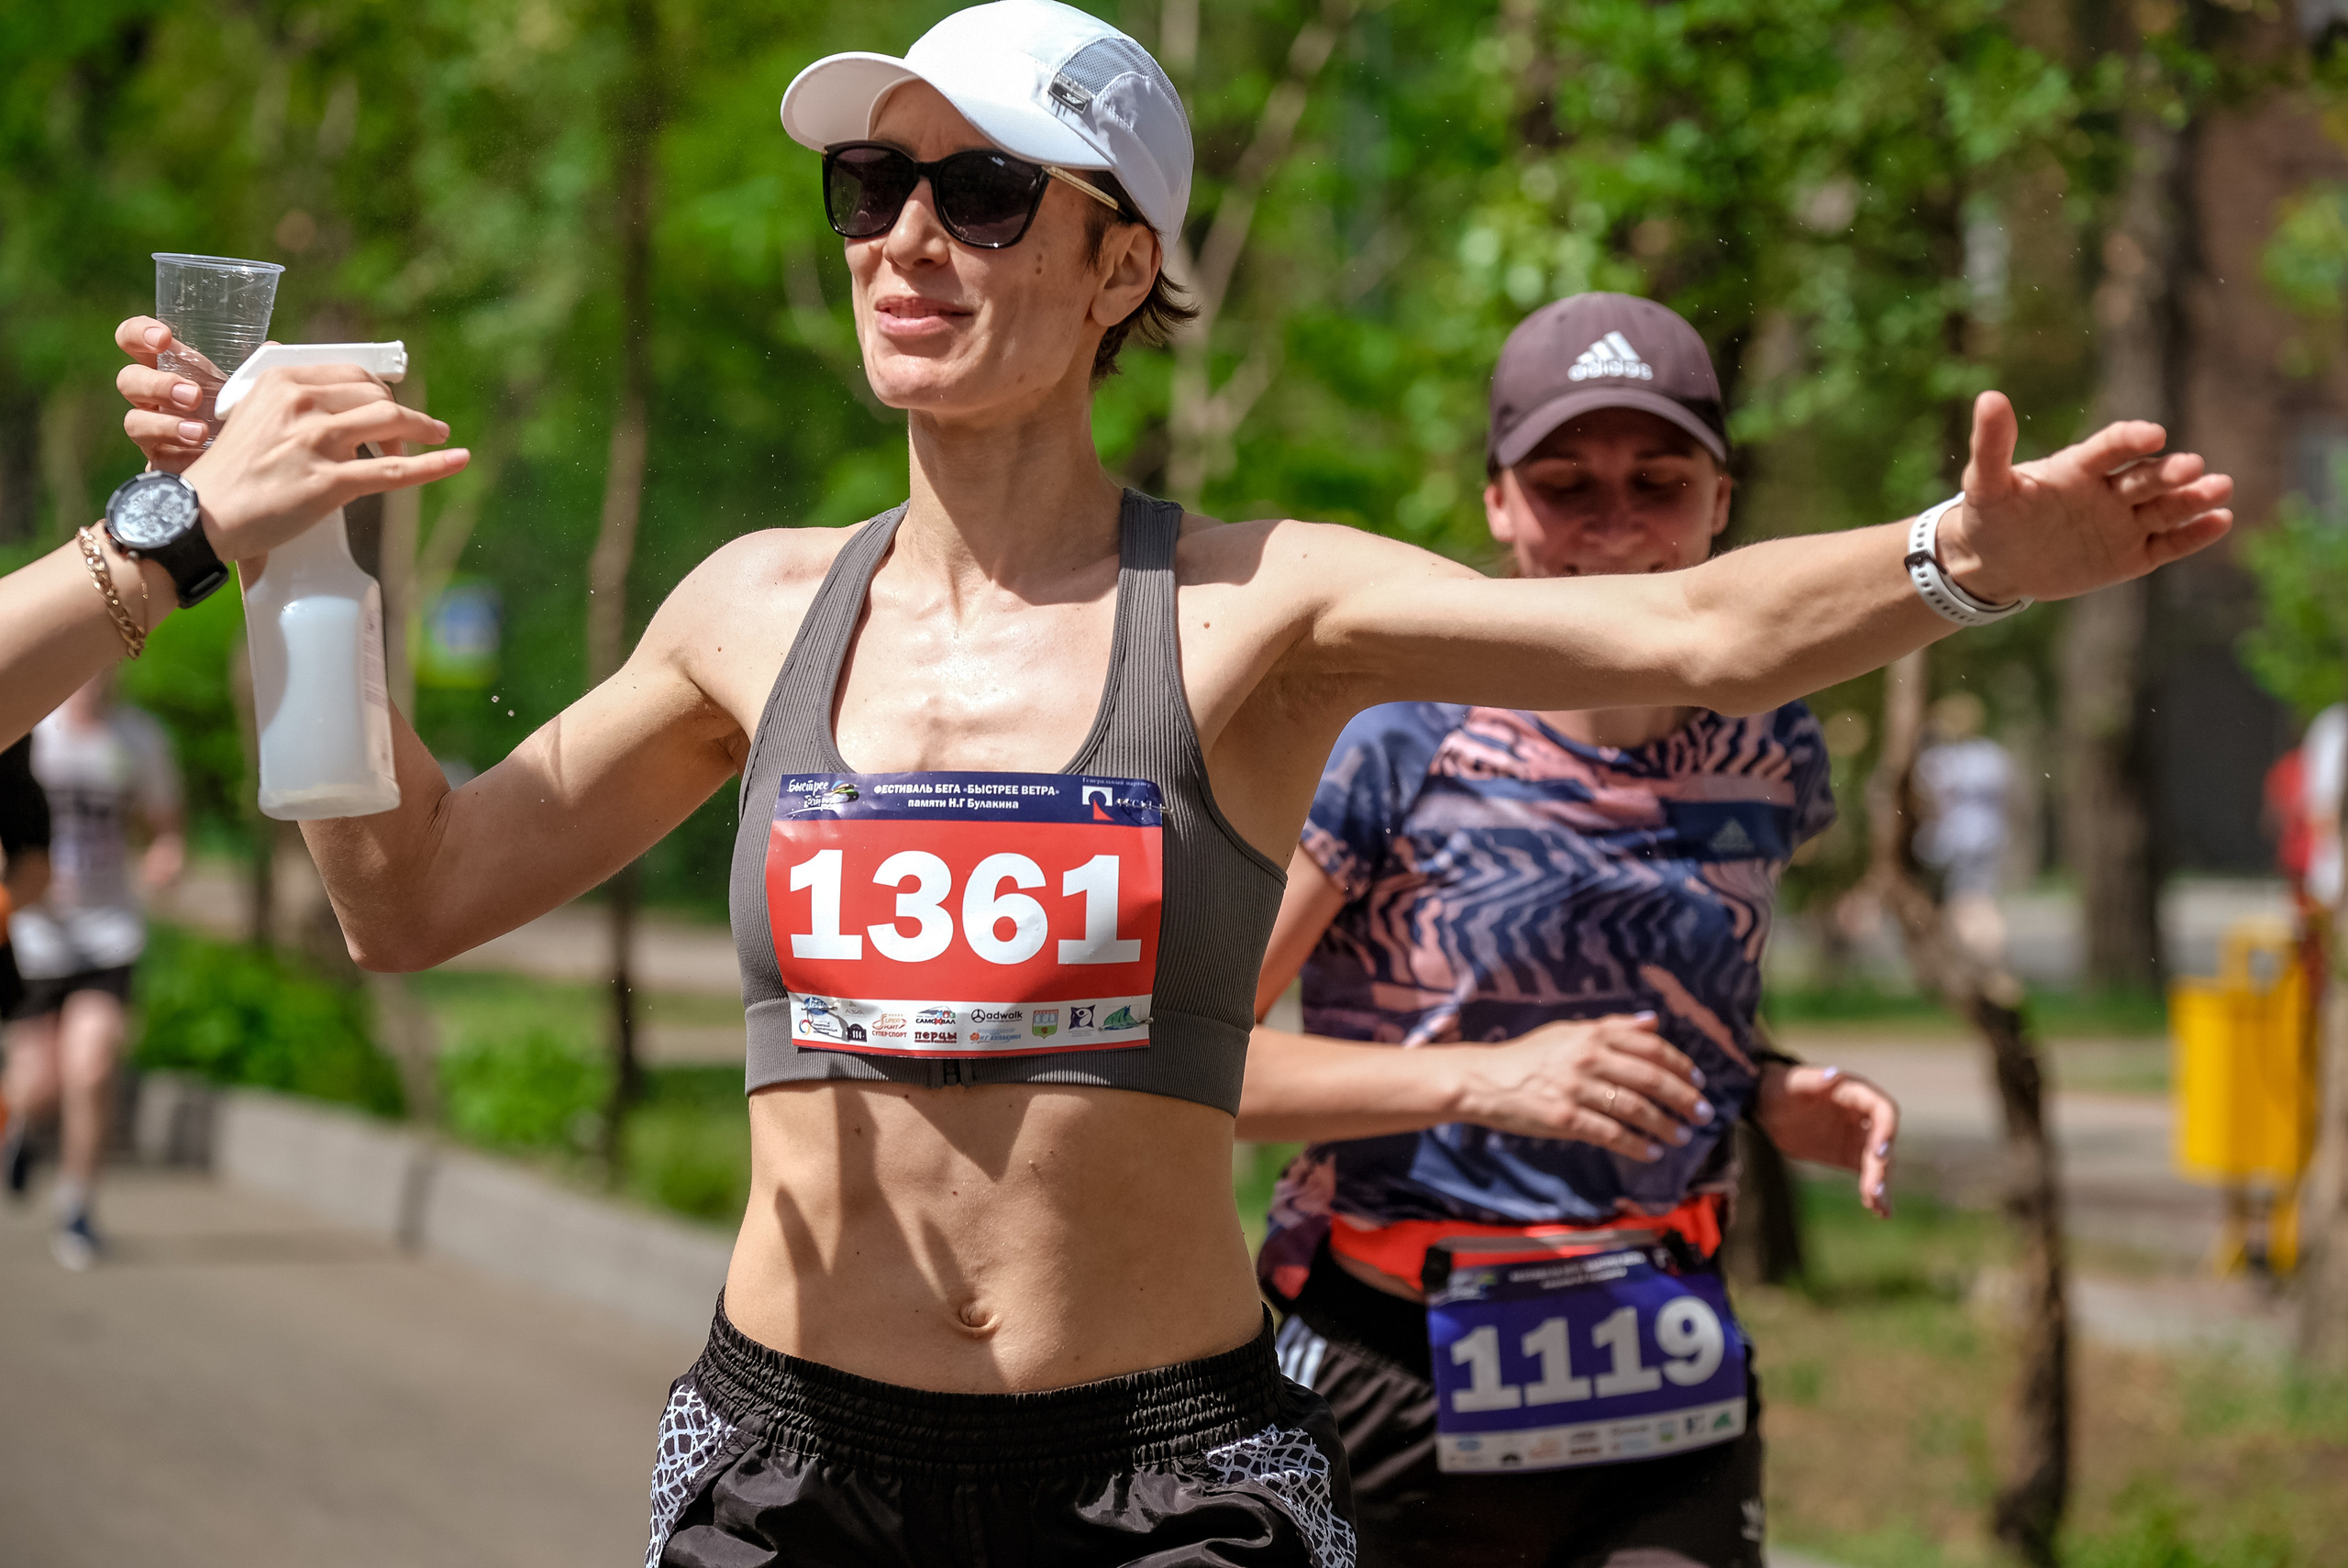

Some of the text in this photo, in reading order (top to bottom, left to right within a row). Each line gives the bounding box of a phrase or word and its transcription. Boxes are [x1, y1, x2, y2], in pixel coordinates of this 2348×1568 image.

[873, 784, 933, 794] ФЕСТИВАЛЬ
[935, 784, 961, 794] БЕГА
[907, 800, 947, 808] памяти
[967, 799, 1019, 810] Булакина
[790, 849, 1142, 965] 1361
[986, 1011, 1023, 1020] adwalk
[914, 1031, 958, 1043] перцы
[1451, 1295, 1725, 1414] 1119
